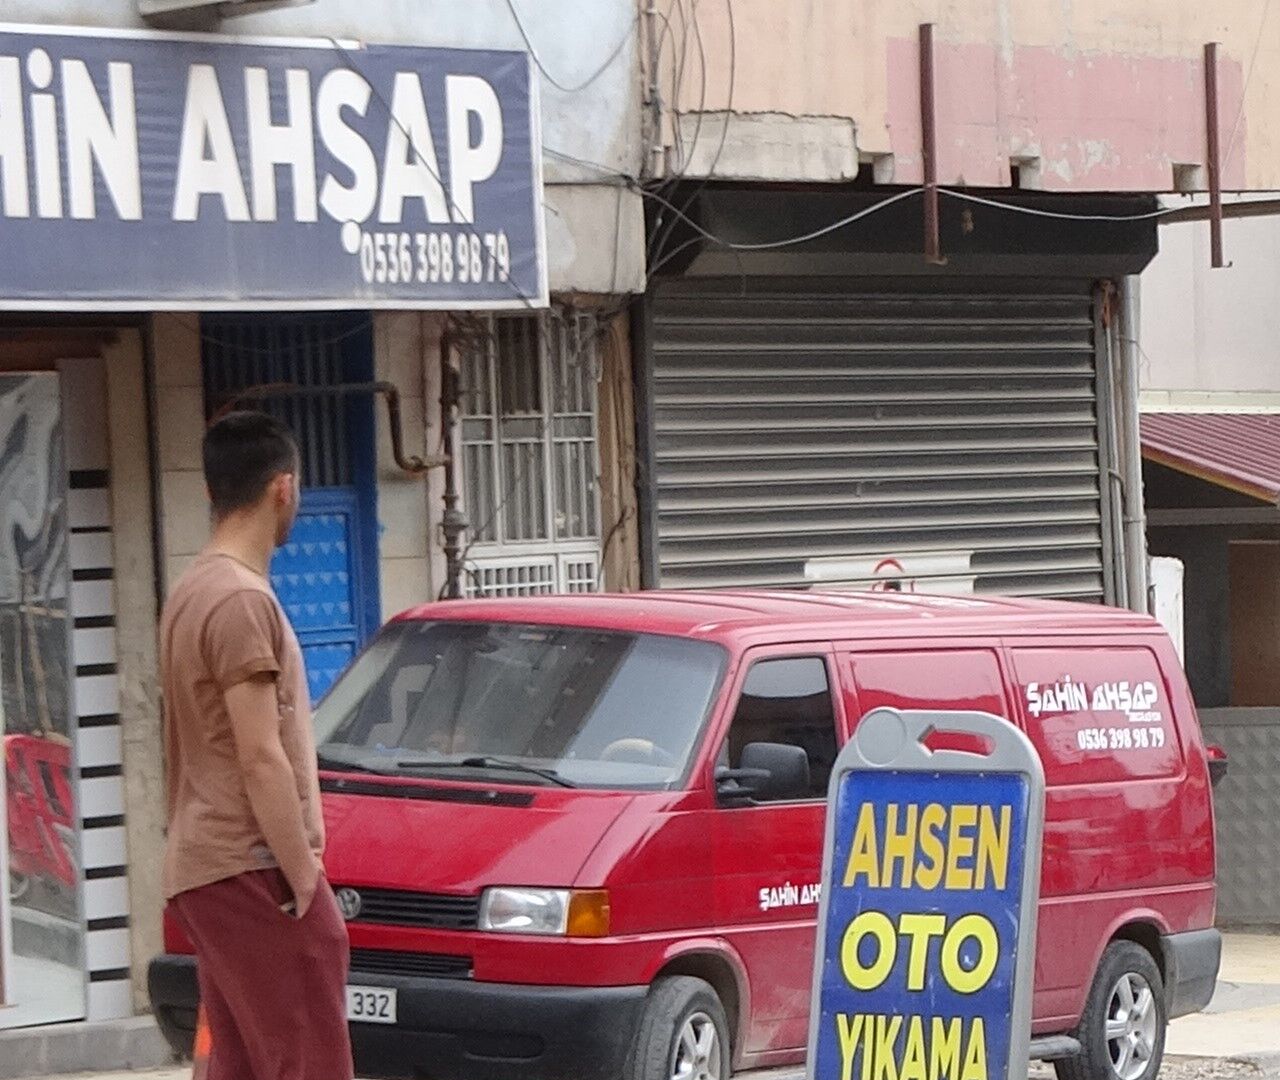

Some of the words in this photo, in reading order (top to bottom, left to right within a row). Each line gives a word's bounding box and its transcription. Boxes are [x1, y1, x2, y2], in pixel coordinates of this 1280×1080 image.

[171, 63, 504, 255] AHŞAP
[360, 231, 412, 284] 0536
[415, 232, 454, 284] 398
[456, 232, 483, 284] 98
[484, 230, 510, 284] 79
[1027, 674, 1088, 717] ŞAHİN
[1092, 681, 1158, 716] AHŞAP
[1077, 728, 1108, 750] 0536
[1109, 728, 1132, 749] 398
[1133, 728, 1148, 748] 98
[1149, 727, 1165, 748] 79
[843, 802, 1012, 890] AHSEN
[759, 881, 798, 911] ŞAHİN
[841, 911, 999, 993] OTO
[353, 992, 389, 1017] 332
